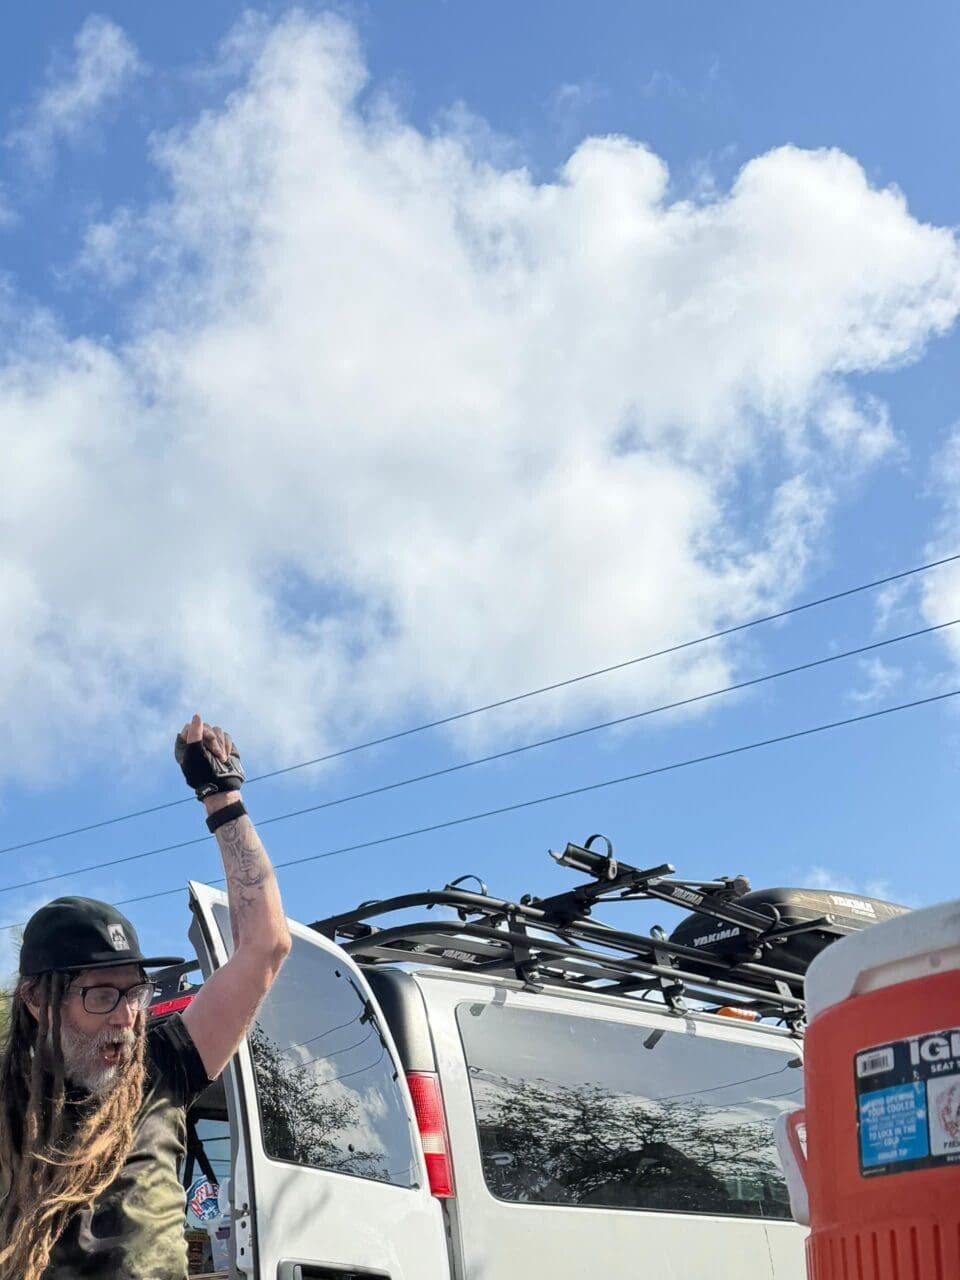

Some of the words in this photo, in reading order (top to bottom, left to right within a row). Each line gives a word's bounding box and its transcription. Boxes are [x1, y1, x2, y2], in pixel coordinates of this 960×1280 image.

[829, 894, 875, 914] YAKIMA
[693, 927, 740, 948] YAKIMA
[441, 949, 477, 961] YAKIMA
[930, 1060, 955, 1073] SEAT
[886, 1101, 916, 1114] COOLER
